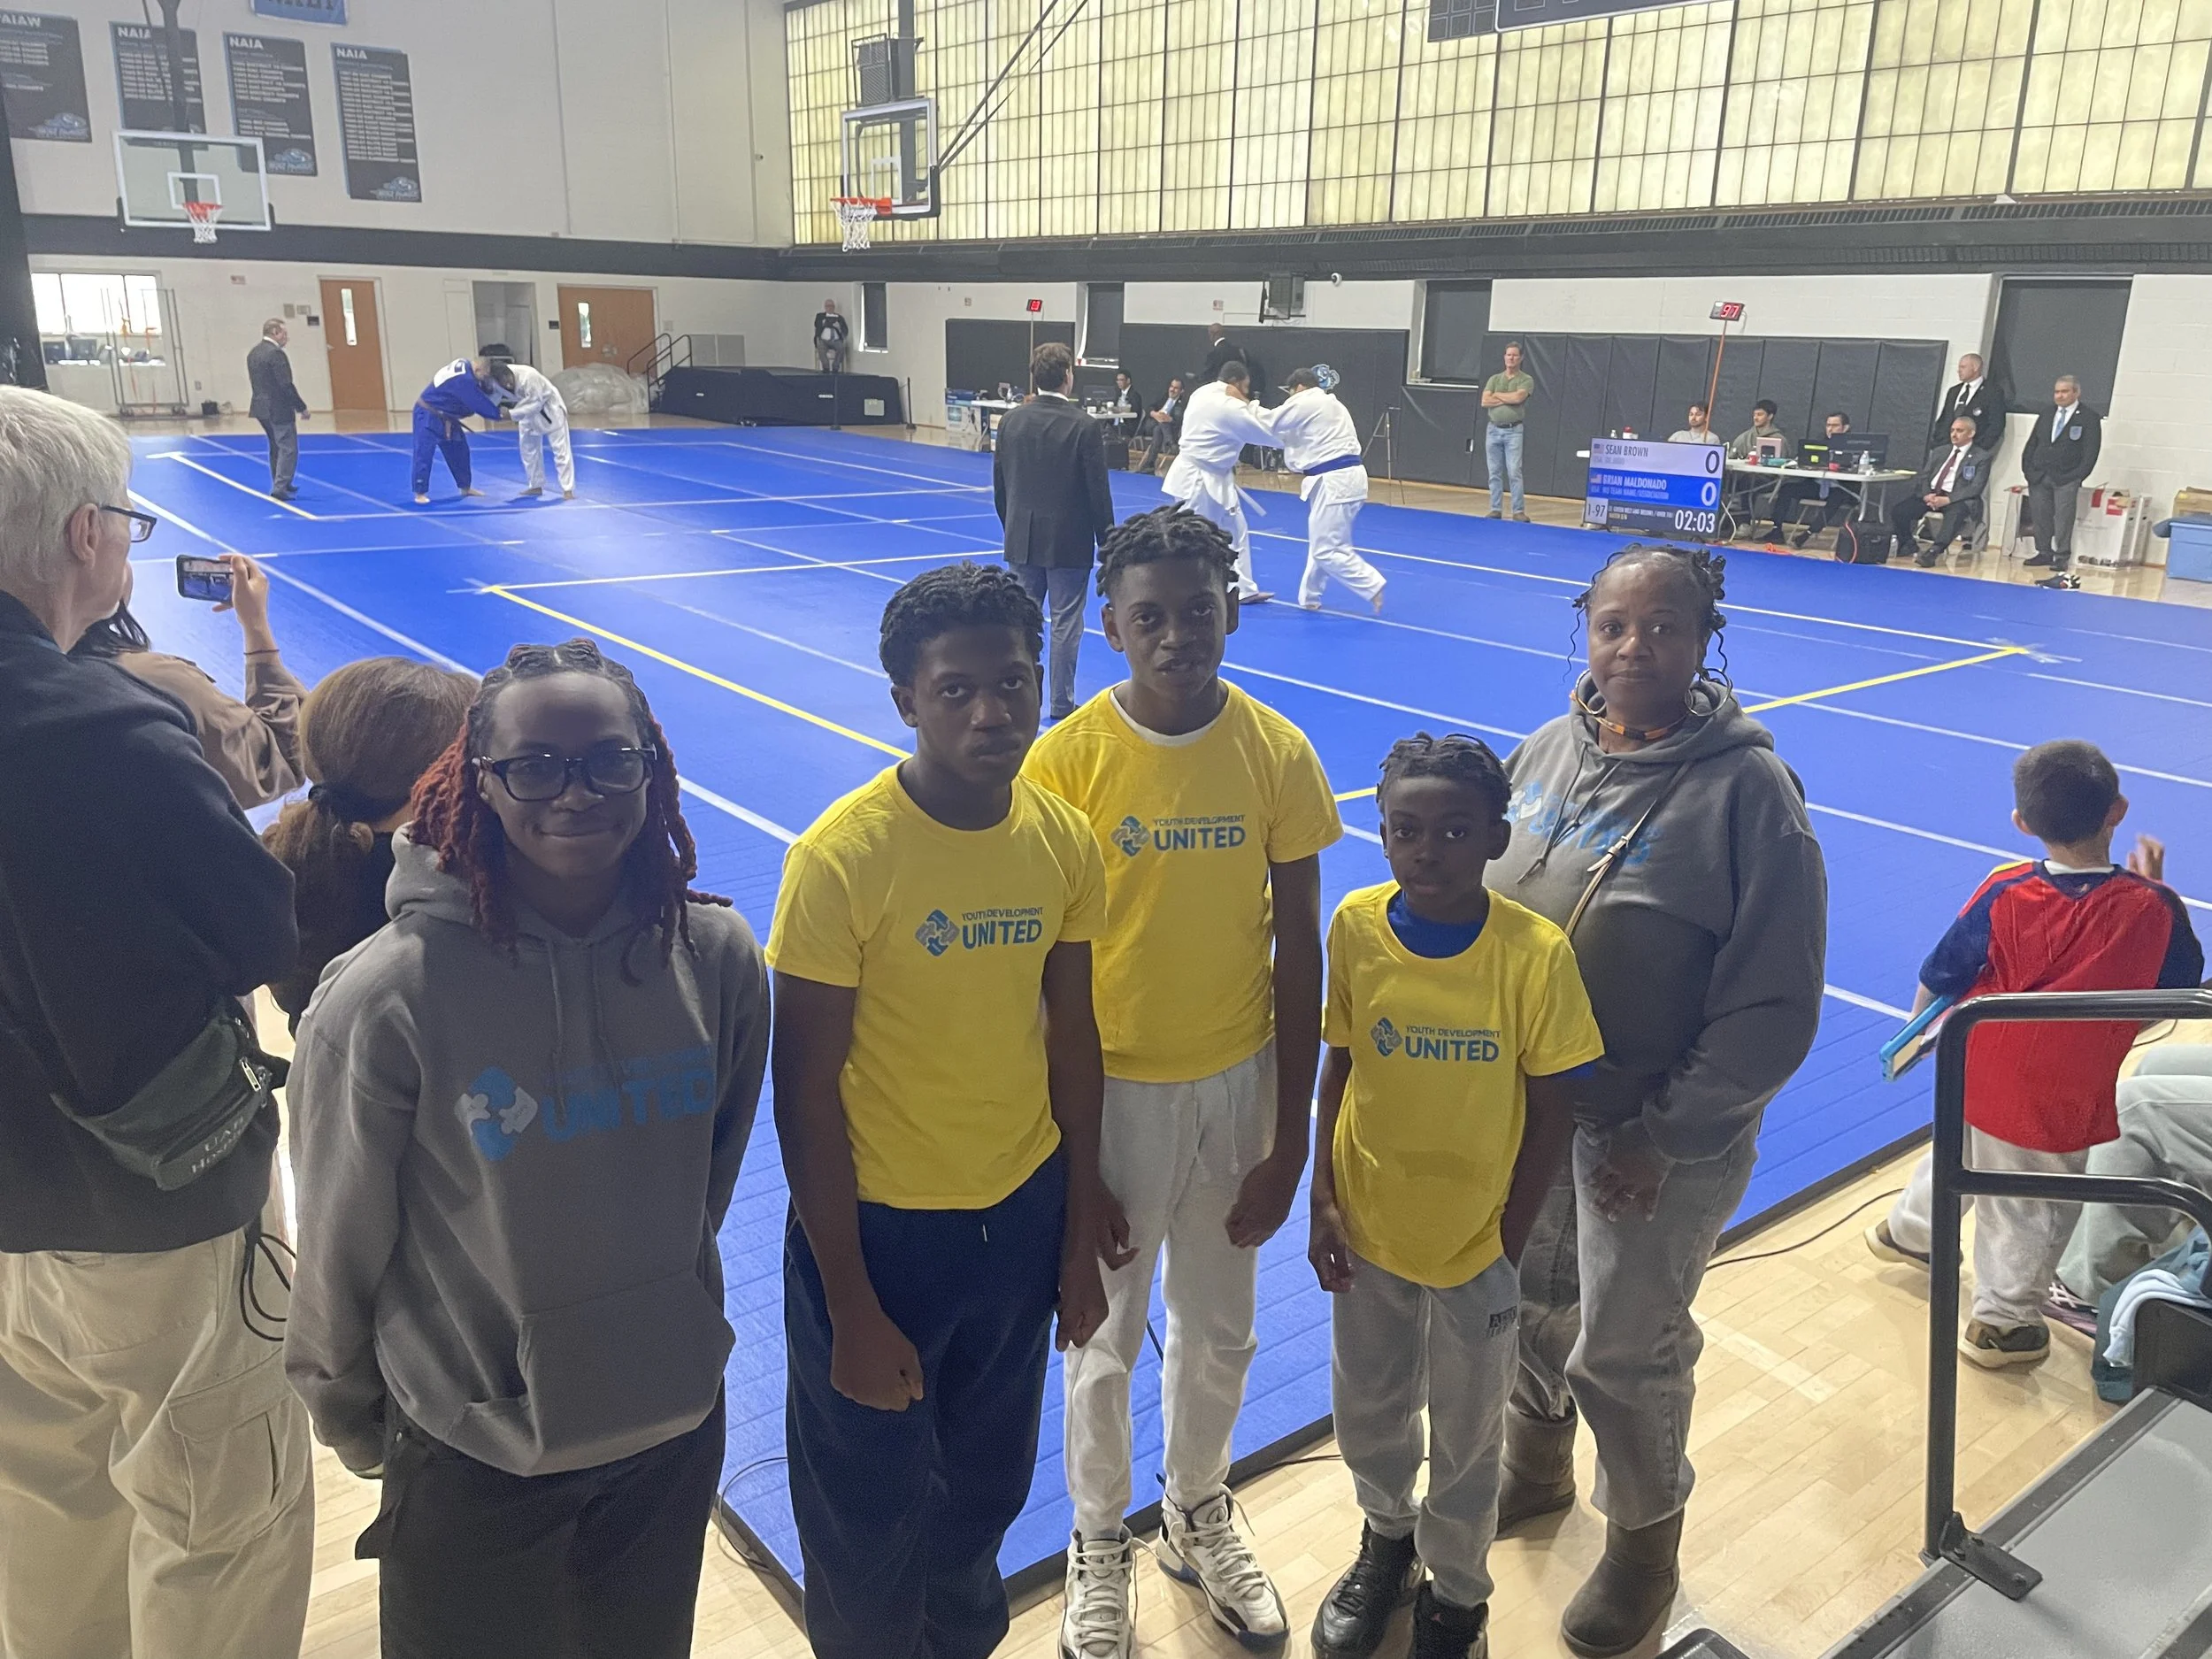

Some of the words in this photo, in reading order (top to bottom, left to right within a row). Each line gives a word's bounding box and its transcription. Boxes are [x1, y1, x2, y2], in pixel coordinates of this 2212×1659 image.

[117, 27, 151, 38] NAIA
[229, 36, 264, 50] NAIA
[336, 47, 367, 59] NAIA
[1720, 304, 1740, 318] 97
[1605, 444, 1622, 455] SEAN
[1623, 446, 1648, 457] BROWN
[1705, 449, 1720, 474] 0
[1602, 474, 1623, 487] BRIAN
[1624, 476, 1667, 490] MALDONADO
[1701, 481, 1717, 507] 0
[1675, 510, 1716, 534] 02:03
[1184, 814, 1246, 826] DEVELOPMENT
[1154, 826, 1247, 851] UNITED
[987, 907, 1043, 918] DEVELOPMENT
[962, 919, 1042, 950] UNITED
[1406, 1025, 1435, 1035] YOUTH
[1438, 1028, 1502, 1038] DEVELOPMENT
[1405, 1036, 1499, 1063] UNITED
[541, 1068, 716, 1141] UNITED
